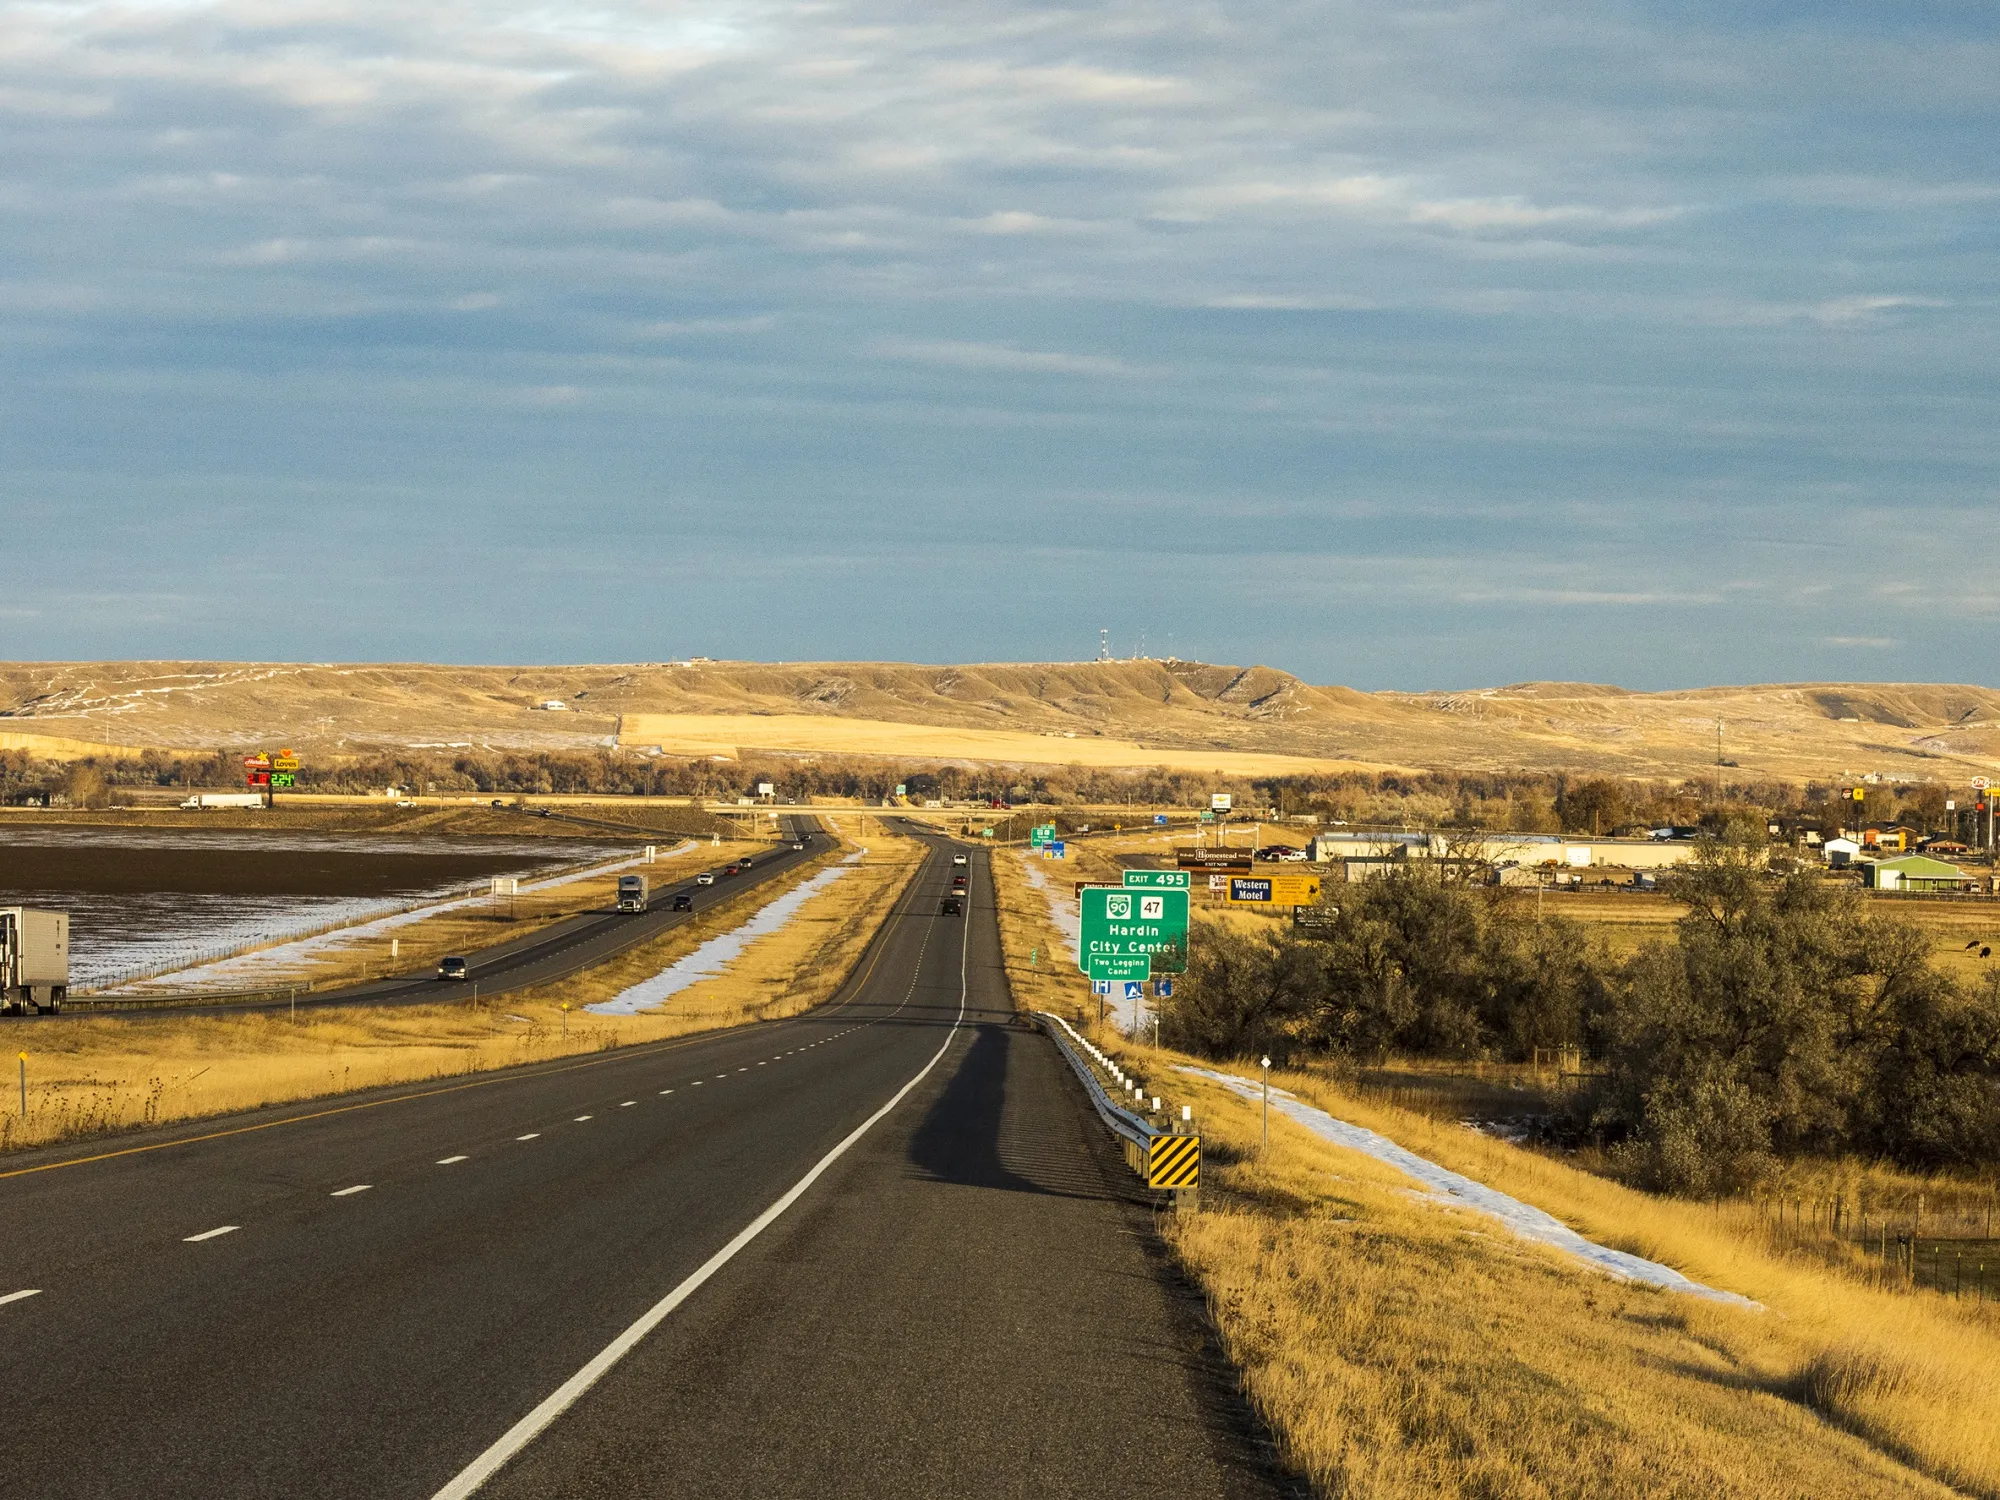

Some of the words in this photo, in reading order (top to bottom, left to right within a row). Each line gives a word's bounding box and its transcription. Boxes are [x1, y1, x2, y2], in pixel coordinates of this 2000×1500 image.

[1198, 850, 1236, 859] Homestead
[1129, 875, 1148, 883] EXIT
[1156, 874, 1184, 885] 495
[1234, 879, 1269, 889] Western
[1238, 890, 1263, 900] Motel
[1110, 903, 1127, 913] 90
[1144, 902, 1160, 913] 47
[1109, 924, 1159, 936] Hardin
[1090, 941, 1120, 954] City
[1113, 959, 1144, 968] Leggins
